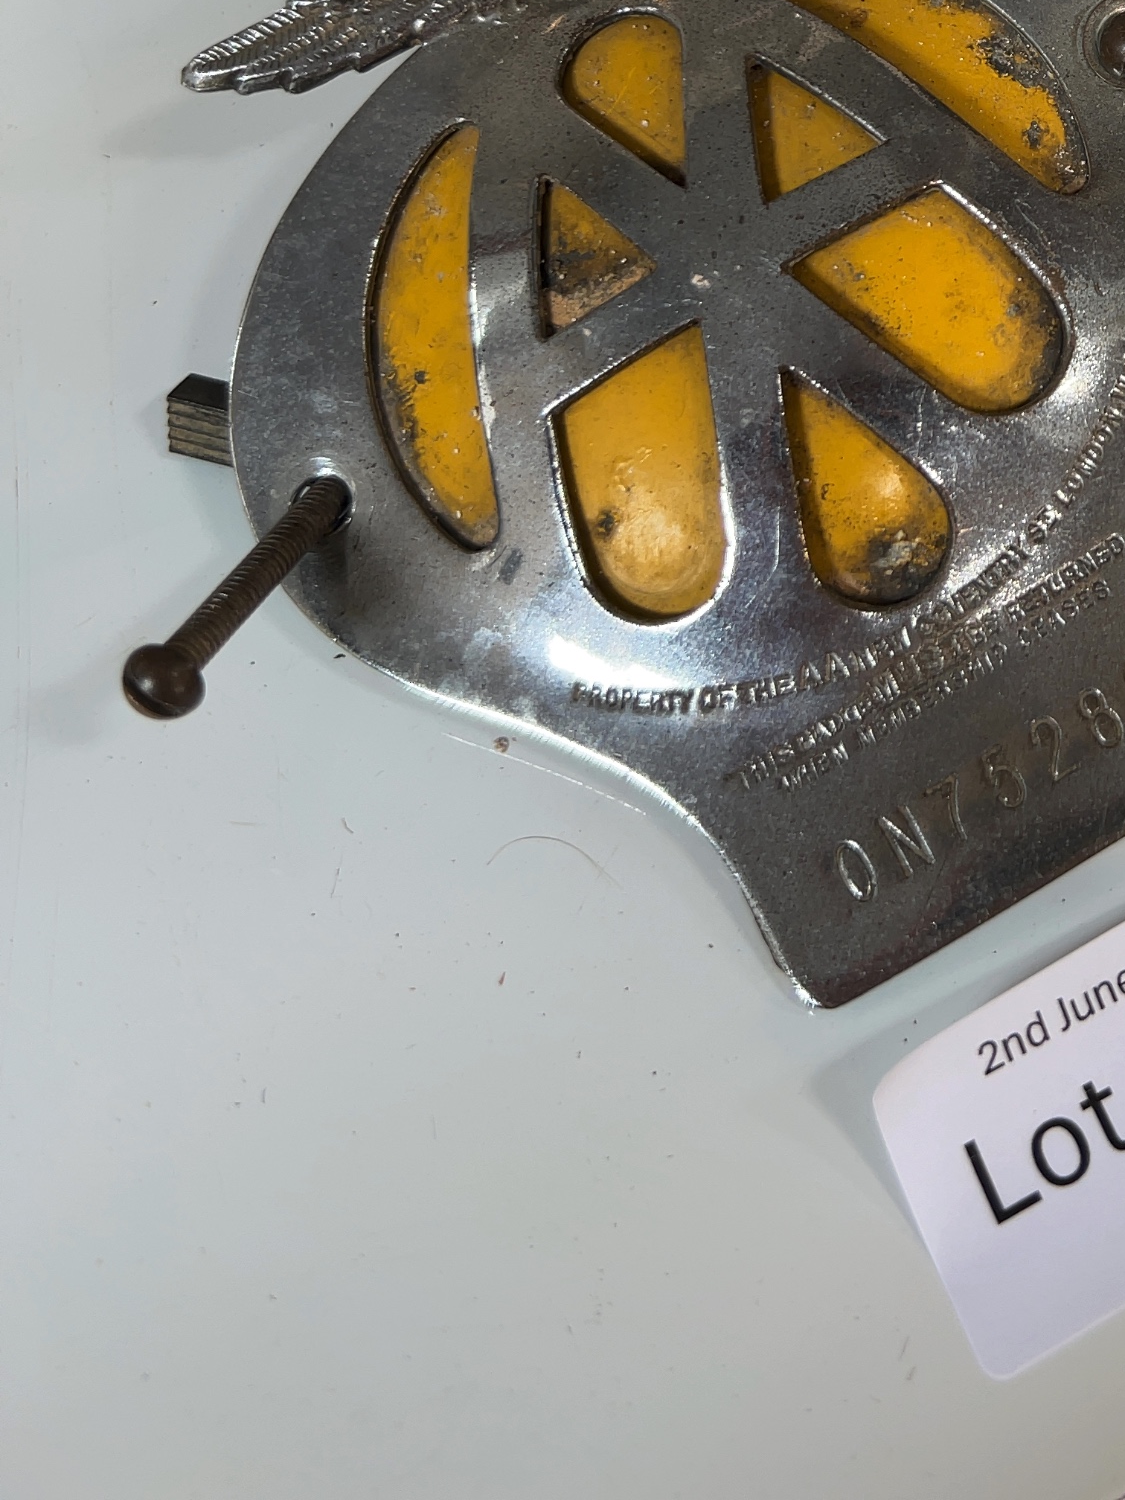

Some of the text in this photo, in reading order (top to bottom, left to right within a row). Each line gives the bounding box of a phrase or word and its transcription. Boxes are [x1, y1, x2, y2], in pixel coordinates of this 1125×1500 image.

[570, 681, 699, 716] PROPERTY
[701, 683, 737, 713] OF
[738, 671, 798, 704] THE
[913, 534, 1036, 637] COVENTRY
[733, 741, 798, 790] THIS
[794, 696, 873, 750] BADGE
[1004, 532, 1125, 624] RETURNED
[775, 579, 1111, 796] WHEN MEMBERSHIP CEASES
[977, 1012, 1050, 1076] 2nd
